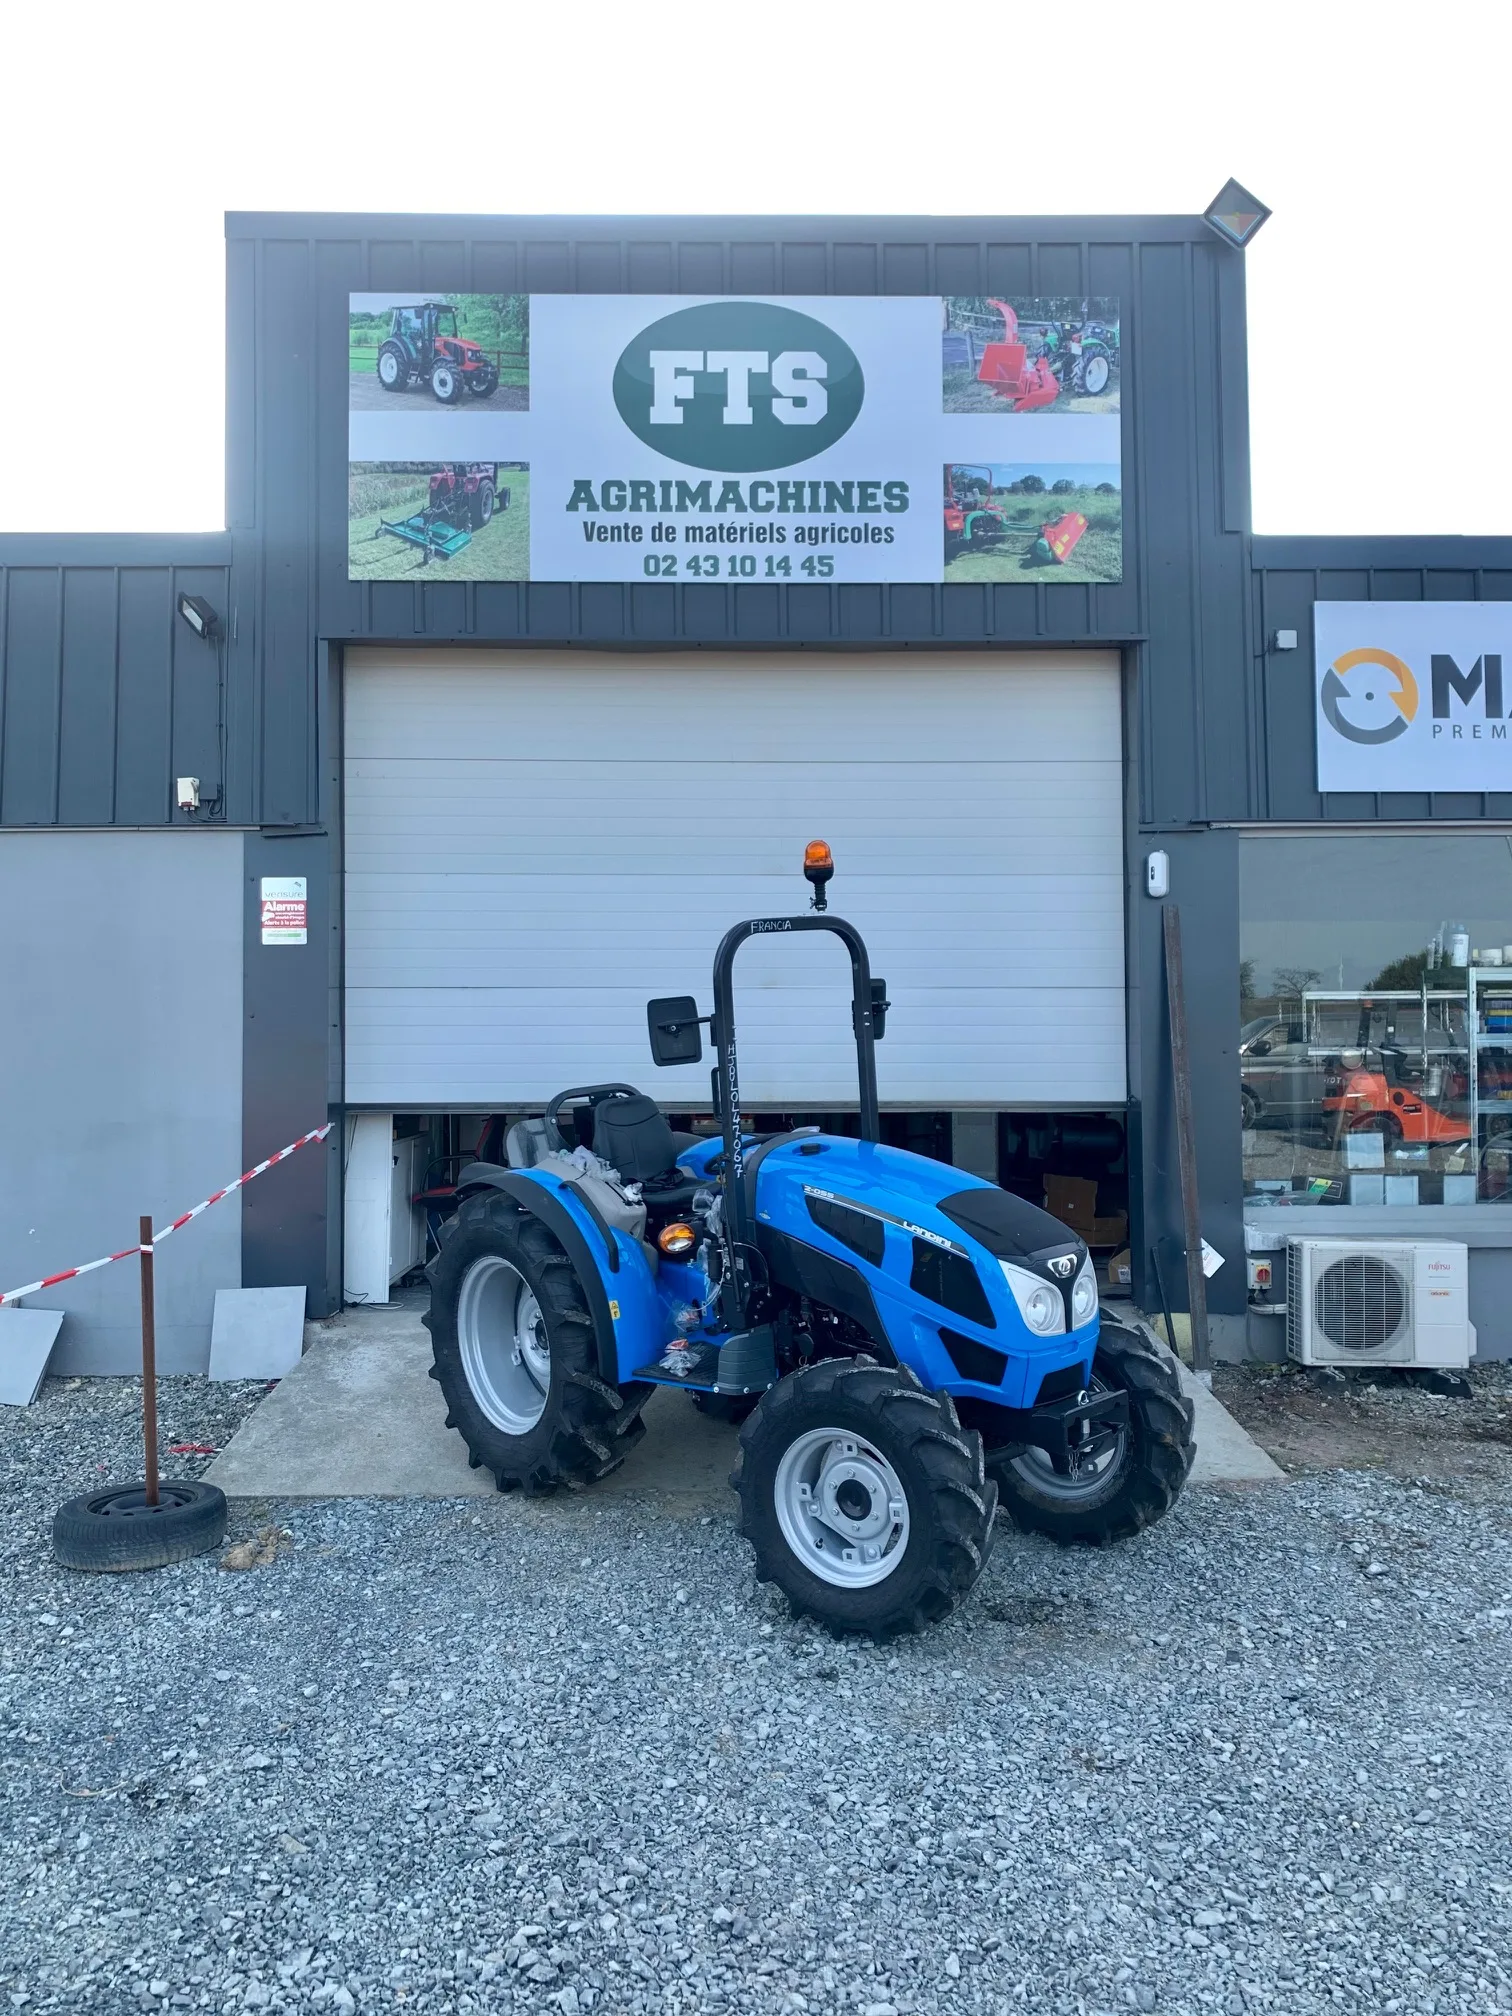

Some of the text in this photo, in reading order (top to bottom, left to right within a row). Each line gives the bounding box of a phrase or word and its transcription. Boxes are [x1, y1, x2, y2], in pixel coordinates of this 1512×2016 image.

[649, 350, 828, 425] FTS
[565, 479, 910, 513] AGRIMACHINES
[583, 521, 895, 546] Vente de matériels agricoles
[643, 554, 834, 577] 02 43 10 14 45
[264, 901, 305, 911] Alarme
[750, 920, 792, 934] FRANCIA
[902, 1221, 952, 1248] LANDINI
[1428, 1261, 1451, 1271] FUJITSU
